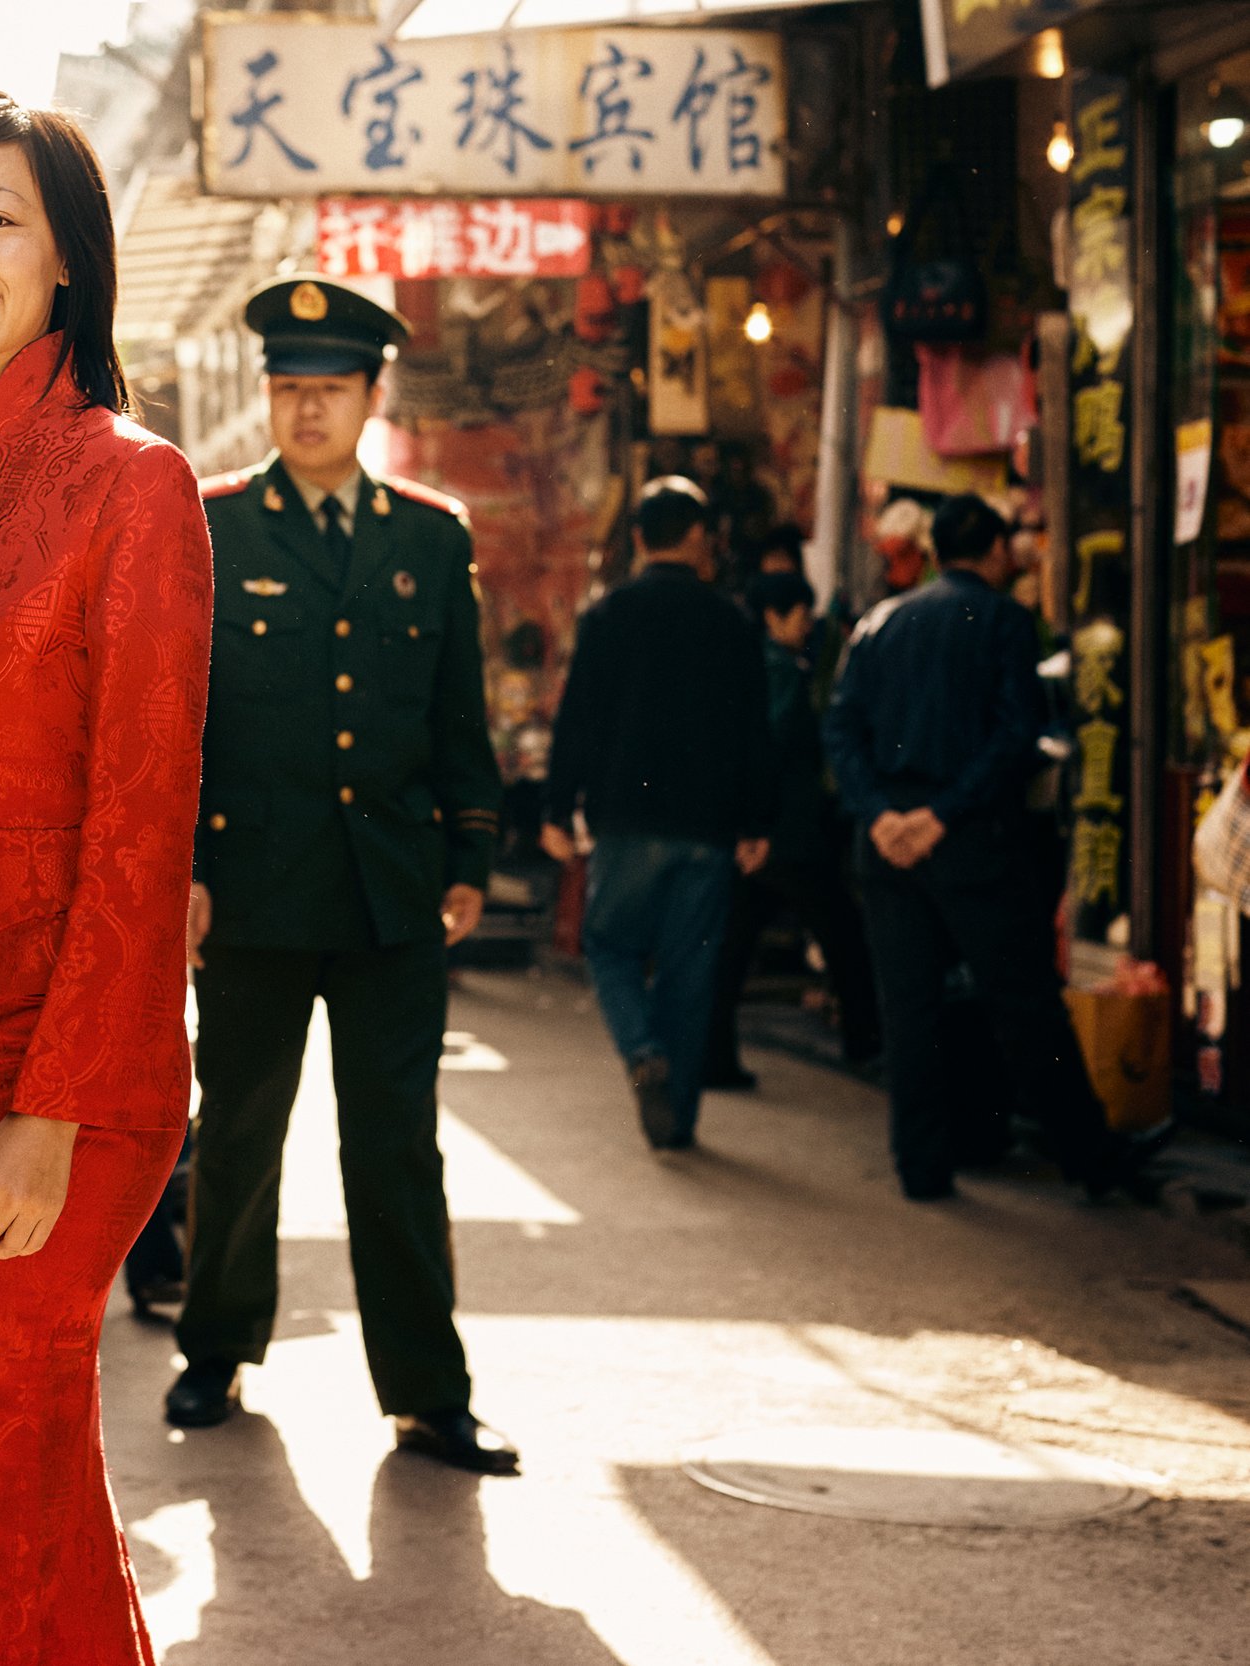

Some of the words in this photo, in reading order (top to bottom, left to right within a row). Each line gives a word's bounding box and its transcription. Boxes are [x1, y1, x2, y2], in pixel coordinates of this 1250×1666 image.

[227, 38, 772, 176] 天宝珠宾馆
